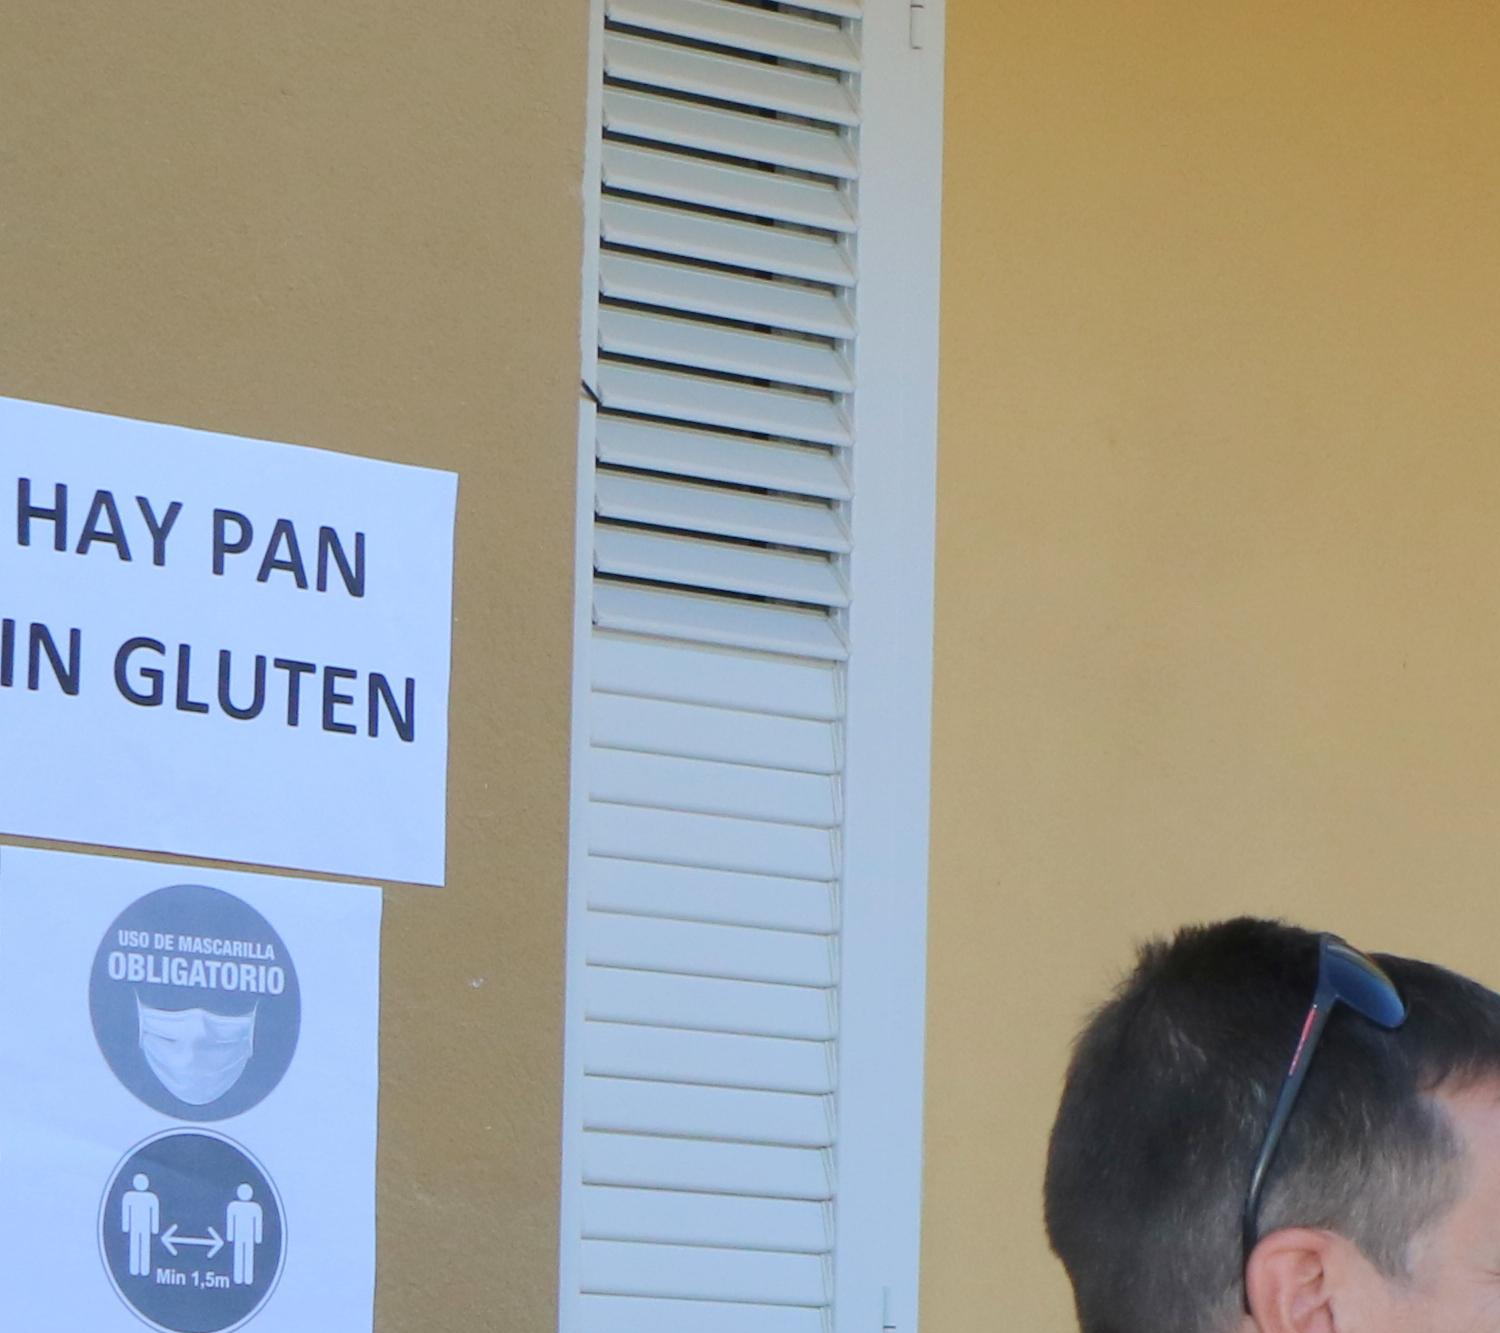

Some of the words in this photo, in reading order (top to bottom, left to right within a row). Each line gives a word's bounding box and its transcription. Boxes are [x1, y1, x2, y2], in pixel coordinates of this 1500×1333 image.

[16, 477, 184, 567] HAY
[212, 507, 366, 599] PAN
[113, 636, 416, 743] GLUTEN
[118, 929, 149, 948] USO
[154, 932, 174, 951] DE
[178, 935, 276, 961] MASCARILLA
[107, 951, 286, 996] OBLIGATORIO
[156, 1267, 187, 1286] Min
[191, 1269, 231, 1290] 1,5m
